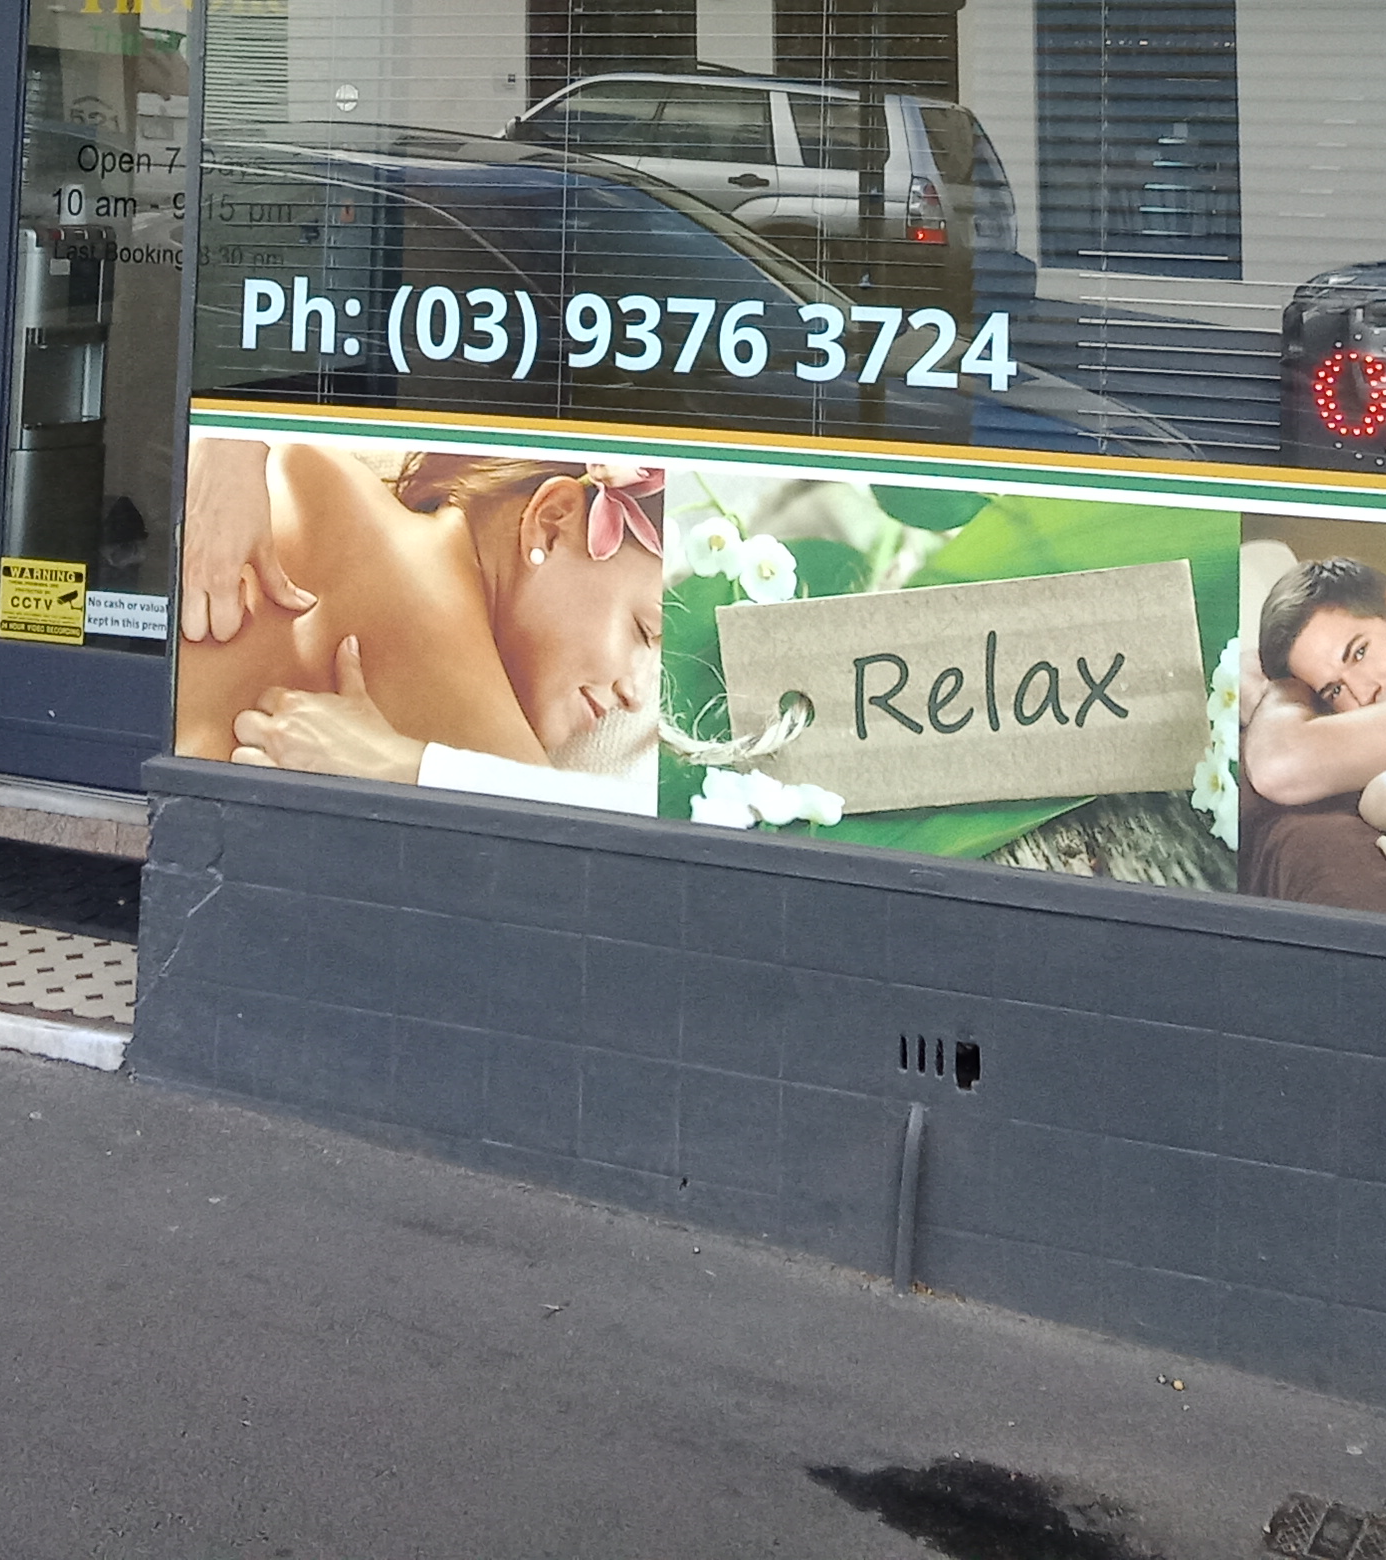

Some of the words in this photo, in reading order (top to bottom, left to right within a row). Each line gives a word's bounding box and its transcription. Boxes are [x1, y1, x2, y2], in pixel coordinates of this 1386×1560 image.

[78, 144, 151, 179] Open
[165, 147, 181, 174] 7
[53, 188, 83, 216] 10
[96, 195, 136, 218] am
[55, 239, 97, 260] Last
[105, 241, 183, 271] Booking
[241, 276, 362, 357] Ph:
[387, 284, 538, 380] (03)
[565, 292, 769, 378] 9376
[795, 302, 1017, 392] 3724
[10, 566, 76, 583] WARNING
[11, 596, 53, 611] CCTV
[88, 596, 102, 608] No
[104, 598, 125, 609] cash
[127, 602, 137, 610] or
[88, 615, 108, 628] kept
[111, 617, 120, 627] in
[122, 618, 140, 629] this
[852, 629, 1129, 740] Relax
